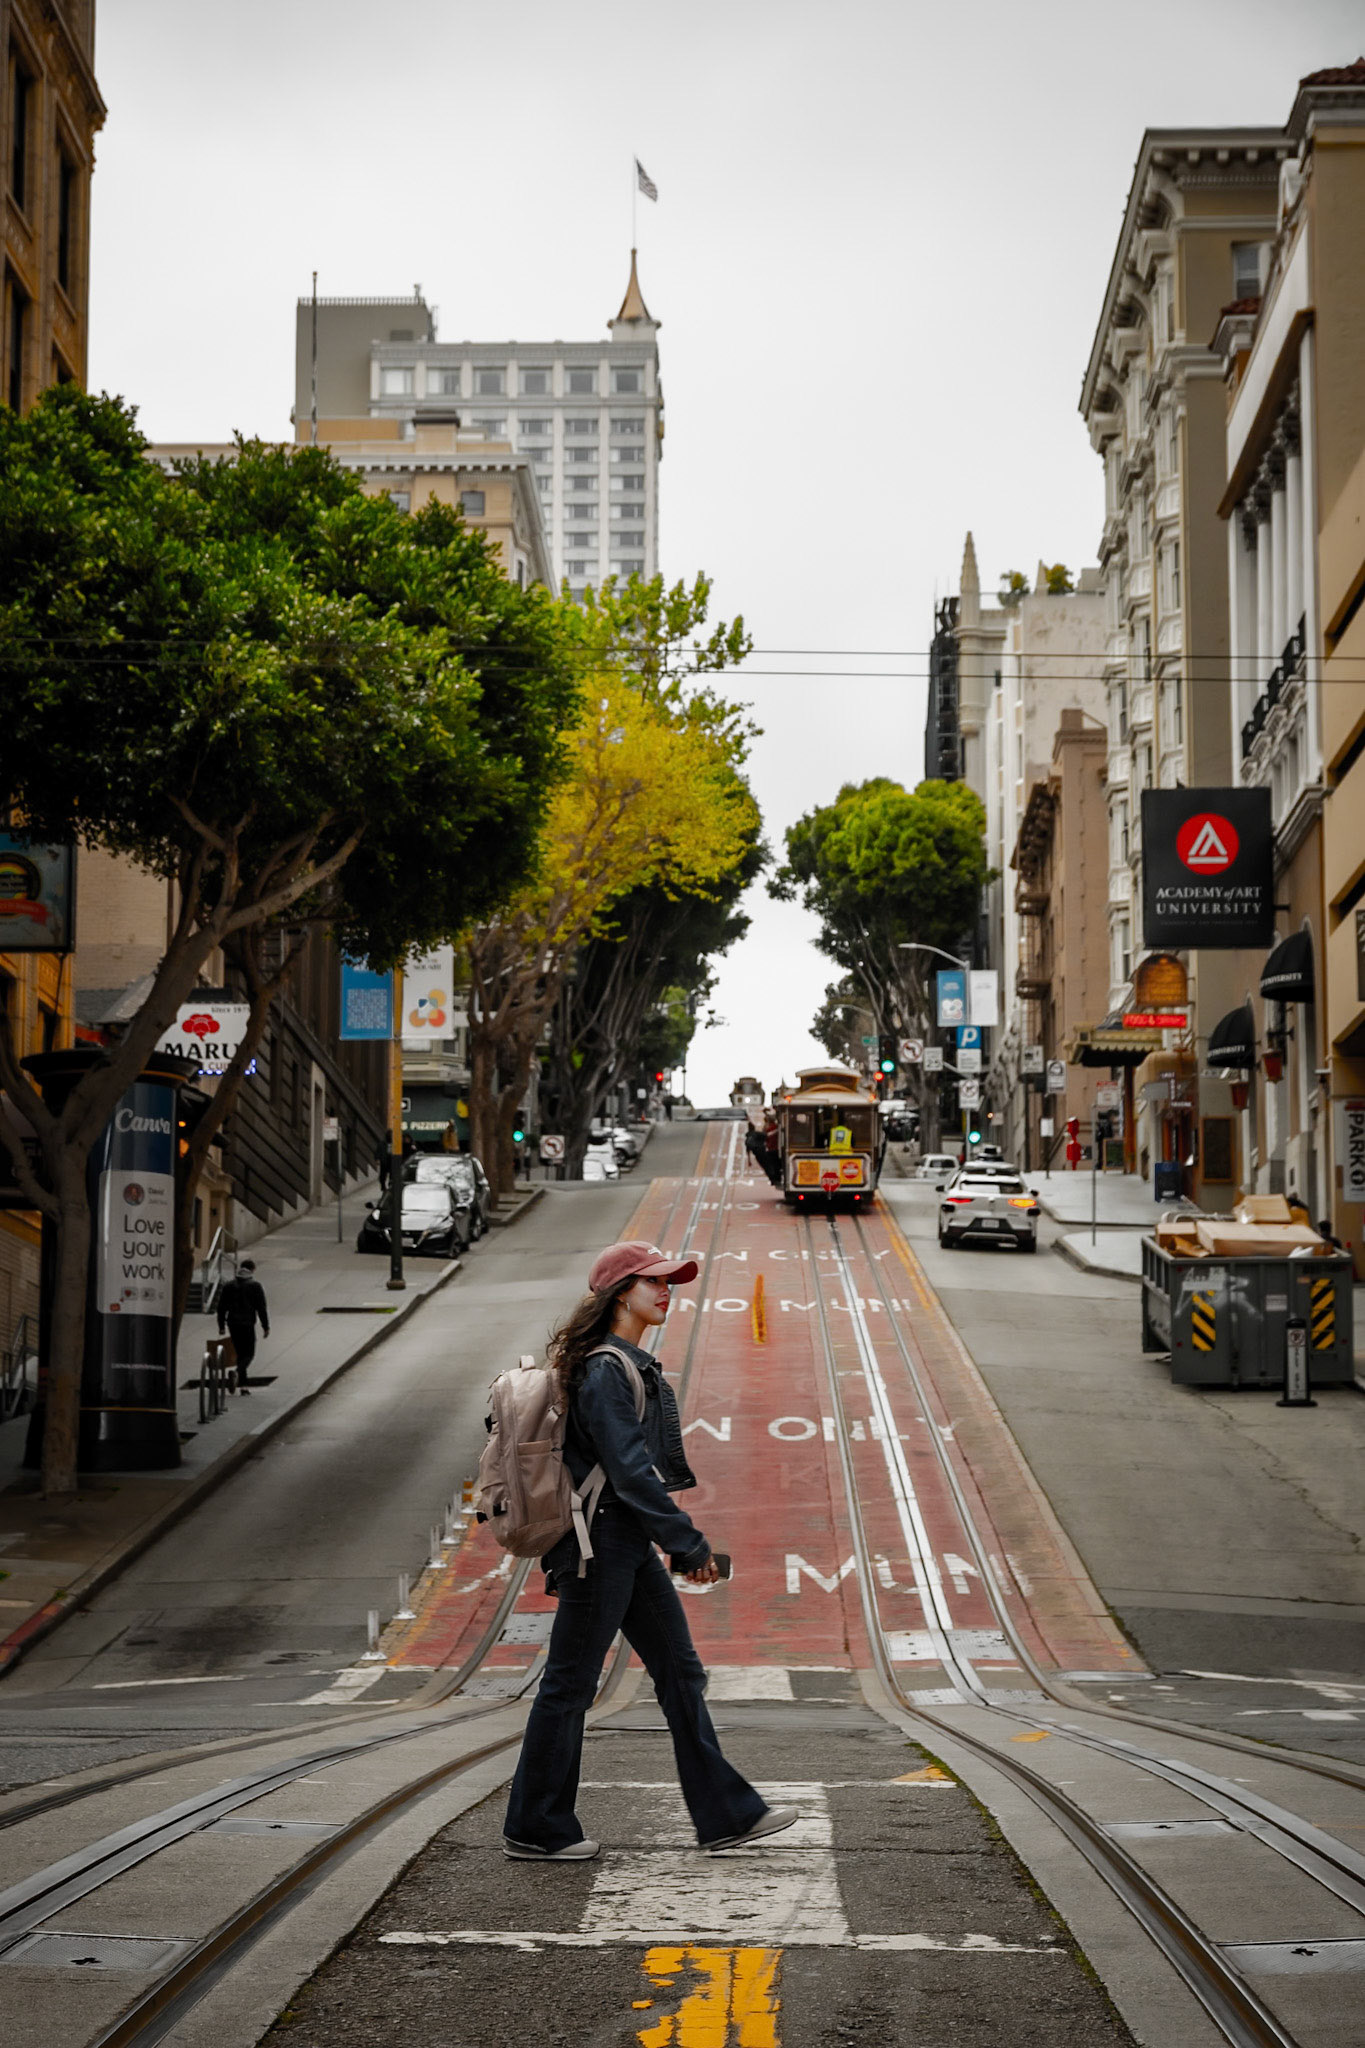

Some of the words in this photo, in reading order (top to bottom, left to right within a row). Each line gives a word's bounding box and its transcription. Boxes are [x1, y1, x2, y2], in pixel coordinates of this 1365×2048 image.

[1156, 887, 1223, 898] ACADEMY
[1223, 888, 1235, 901] of
[1236, 887, 1262, 898] ART
[1156, 903, 1261, 914] UNIVERSITY
[114, 1107, 171, 1135] Canva
[124, 1214, 165, 1235] Love
[122, 1241, 165, 1259] your
[122, 1263, 165, 1281] work
